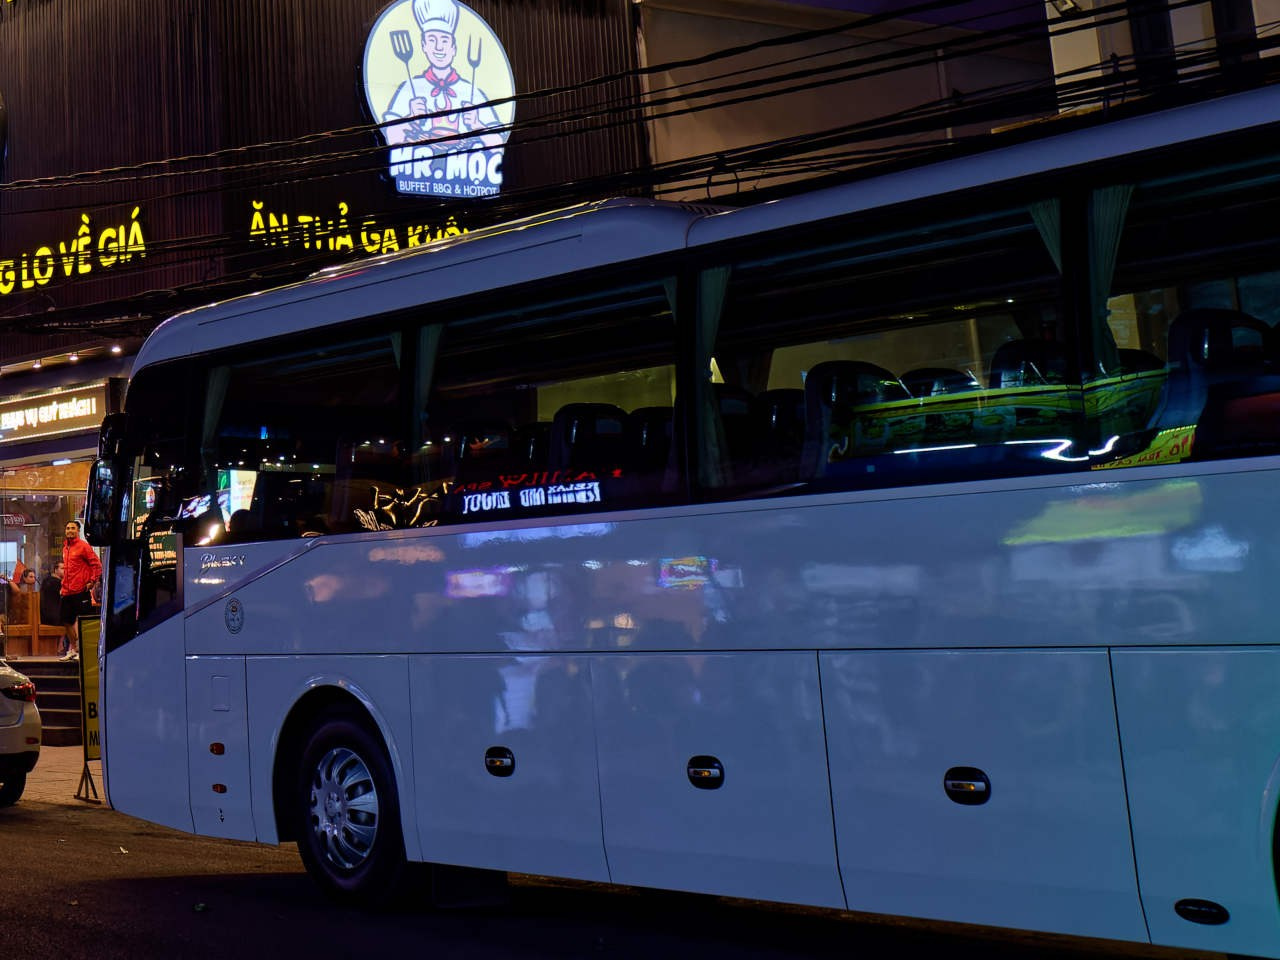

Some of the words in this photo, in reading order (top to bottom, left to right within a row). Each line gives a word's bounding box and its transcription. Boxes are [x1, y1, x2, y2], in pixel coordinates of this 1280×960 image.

[399, 180, 431, 193] BUFFET
[433, 182, 452, 194] BBQ
[454, 184, 461, 194] &
[463, 185, 497, 196] HOTPOT
[21, 246, 53, 289] LO
[59, 214, 92, 277] VỀ
[97, 206, 147, 269] GIÁ
[249, 201, 289, 247] ĂN
[298, 202, 354, 251] THẢ
[360, 221, 400, 254] GA
